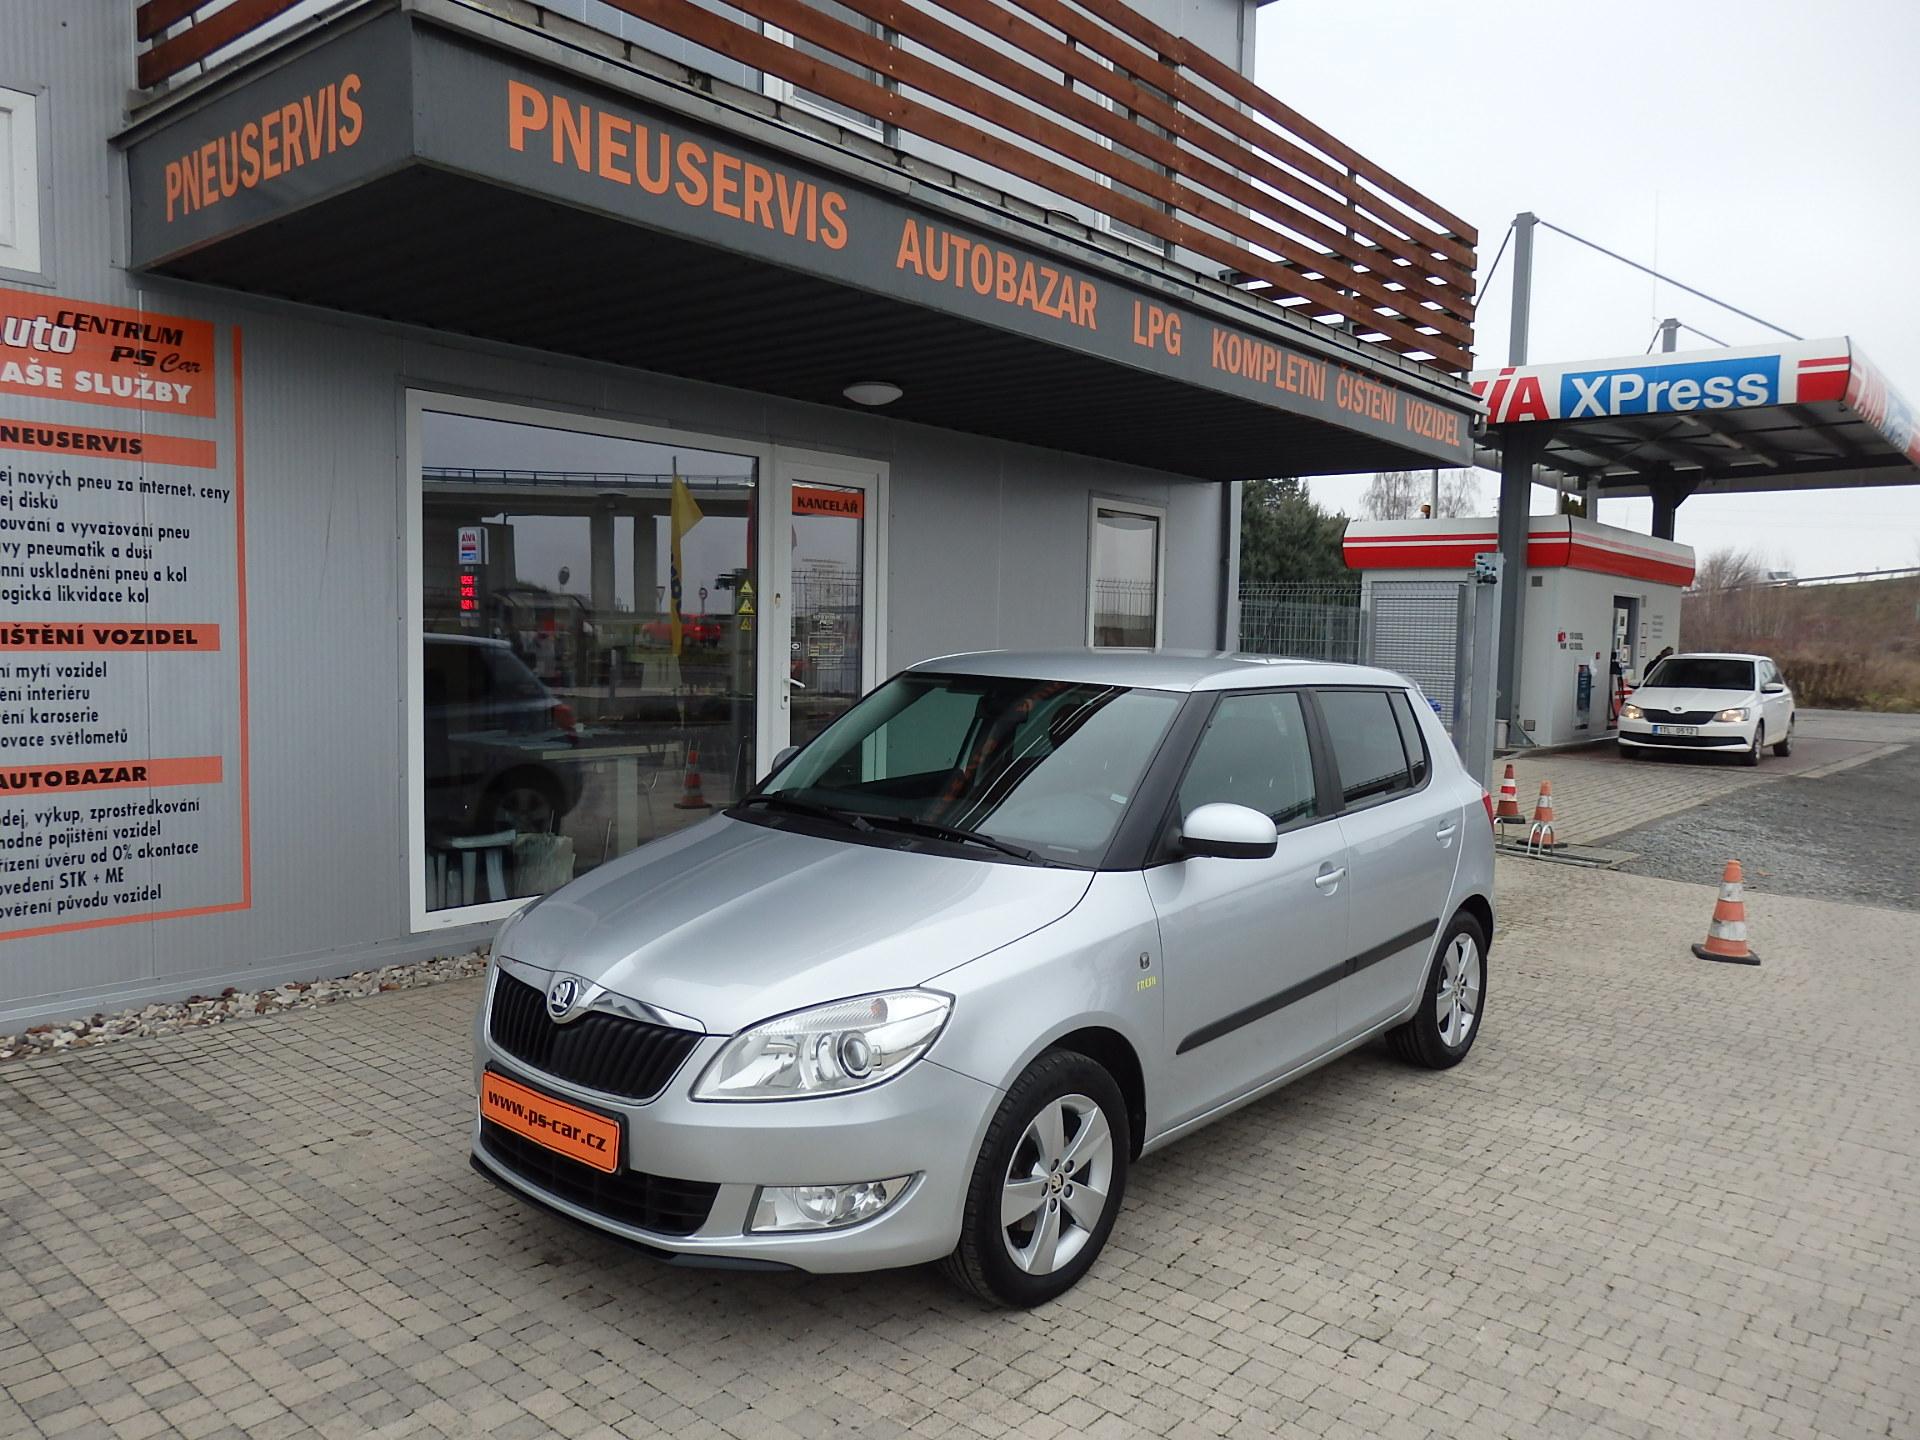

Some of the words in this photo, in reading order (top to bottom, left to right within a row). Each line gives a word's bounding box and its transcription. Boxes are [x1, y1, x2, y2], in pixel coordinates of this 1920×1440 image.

[166, 73, 363, 222] PNEUSERVIS
[508, 79, 849, 251] PNEUSERVIS
[896, 217, 1098, 330] AUTOBAZAR
[1133, 300, 1183, 357] LPG
[1211, 327, 1328, 402] KOMPLETNÍ
[1405, 397, 1460, 447] VOZIDEL
[0, 315, 77, 355] uto
[56, 310, 184, 347] CENTRUM
[110, 345, 158, 368] PS
[159, 352, 203, 374] Car
[74, 371, 193, 405] SLUŽBY
[1567, 372, 1771, 418] XPress
[0, 426, 144, 456] NEUSERVIS
[18, 469, 71, 490] nových
[78, 475, 112, 492] pneu
[117, 479, 134, 492] za
[139, 477, 196, 497] internet.
[200, 486, 230, 504] ceny
[19, 491, 59, 510] disků
[56, 521, 65, 533] a
[71, 519, 153, 539] vyvažování
[158, 525, 191, 542] pneu
[27, 541, 105, 559] pneumatik
[112, 549, 120, 557] a
[126, 542, 153, 559] duší
[30, 561, 110, 580] uskladnění
[115, 569, 148, 584] pneu
[153, 572, 161, 582] a
[167, 565, 187, 582] kol
[58, 585, 122, 602] likvidace
[128, 586, 149, 603] kol
[92, 629, 198, 645] VOZIDEL
[16, 663, 50, 682] mytí
[56, 661, 107, 678] vozidel
[28, 684, 90, 701] interiéru
[0, 709, 24, 724] ění
[30, 706, 99, 723] karoserie
[50, 728, 128, 746] světlometů
[0, 808, 28, 829] dej,
[35, 805, 84, 828] výkup,
[90, 798, 200, 824] zprostředkování
[49, 828, 108, 849] pojištění
[113, 820, 161, 841] vozidel
[45, 852, 85, 869] úvěru
[91, 847, 107, 864] od
[138, 842, 199, 859] akontace
[60, 869, 87, 889] STK
[93, 874, 100, 884] +
[105, 866, 125, 883] ME
[57, 891, 108, 914] původu
[113, 884, 162, 905] vozidel
[488, 1090, 607, 1153] www.ps-car.cz
